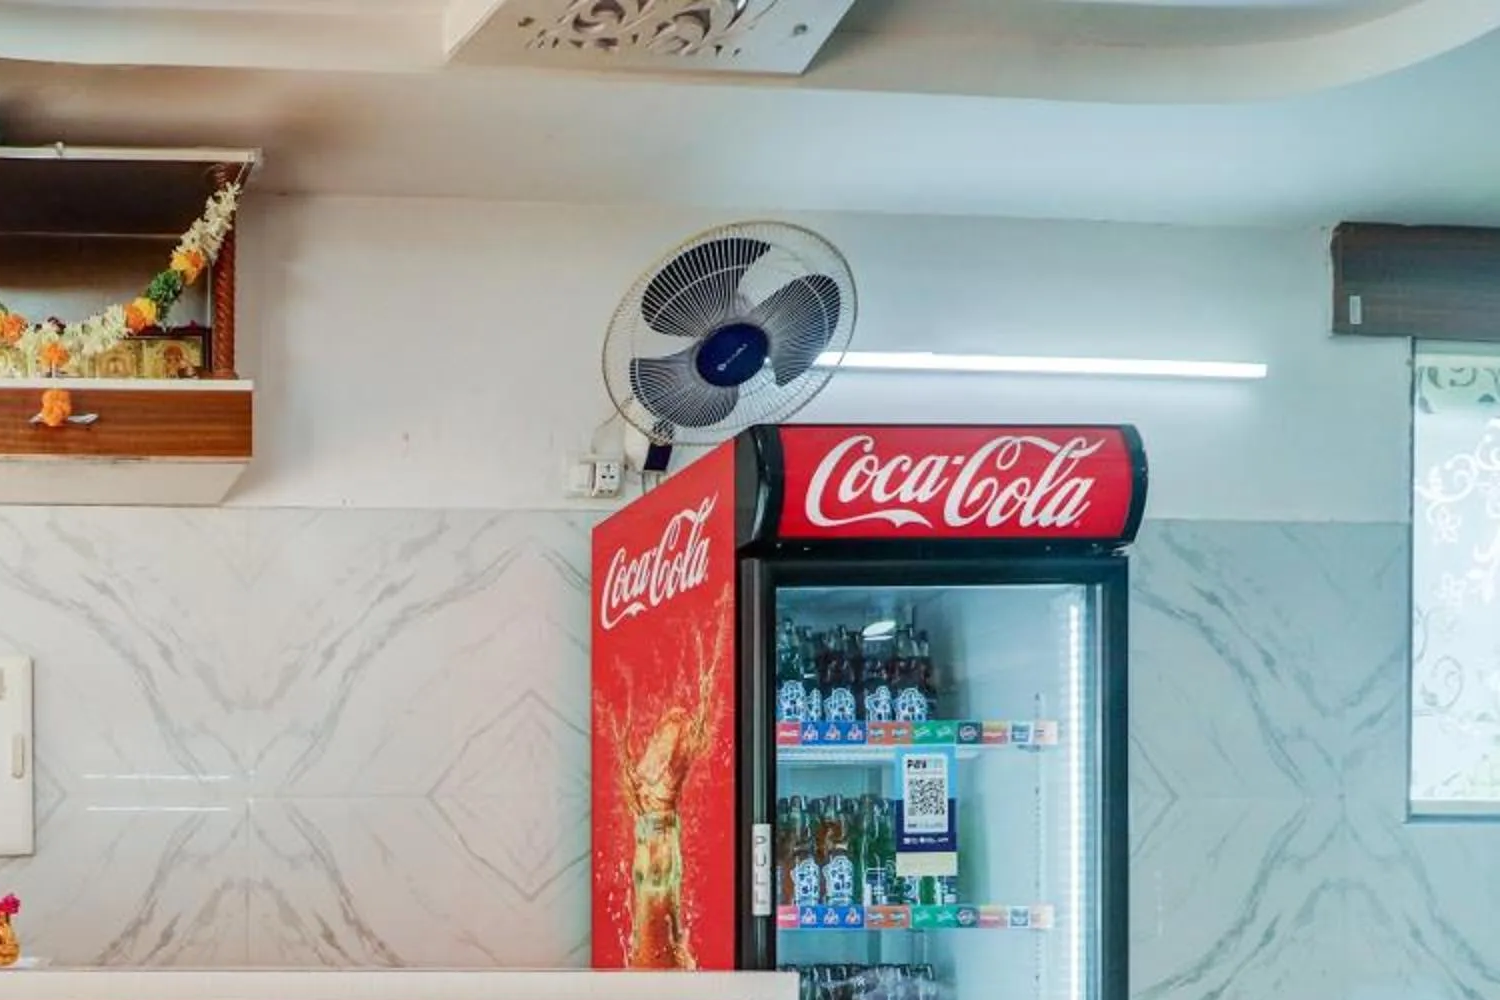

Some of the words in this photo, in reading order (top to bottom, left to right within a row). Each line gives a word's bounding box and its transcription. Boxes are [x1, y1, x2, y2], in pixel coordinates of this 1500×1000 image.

[804, 434, 1107, 529] Coca-Cola
[600, 491, 719, 630] Coca-Cola
[755, 835, 768, 905] PULL
